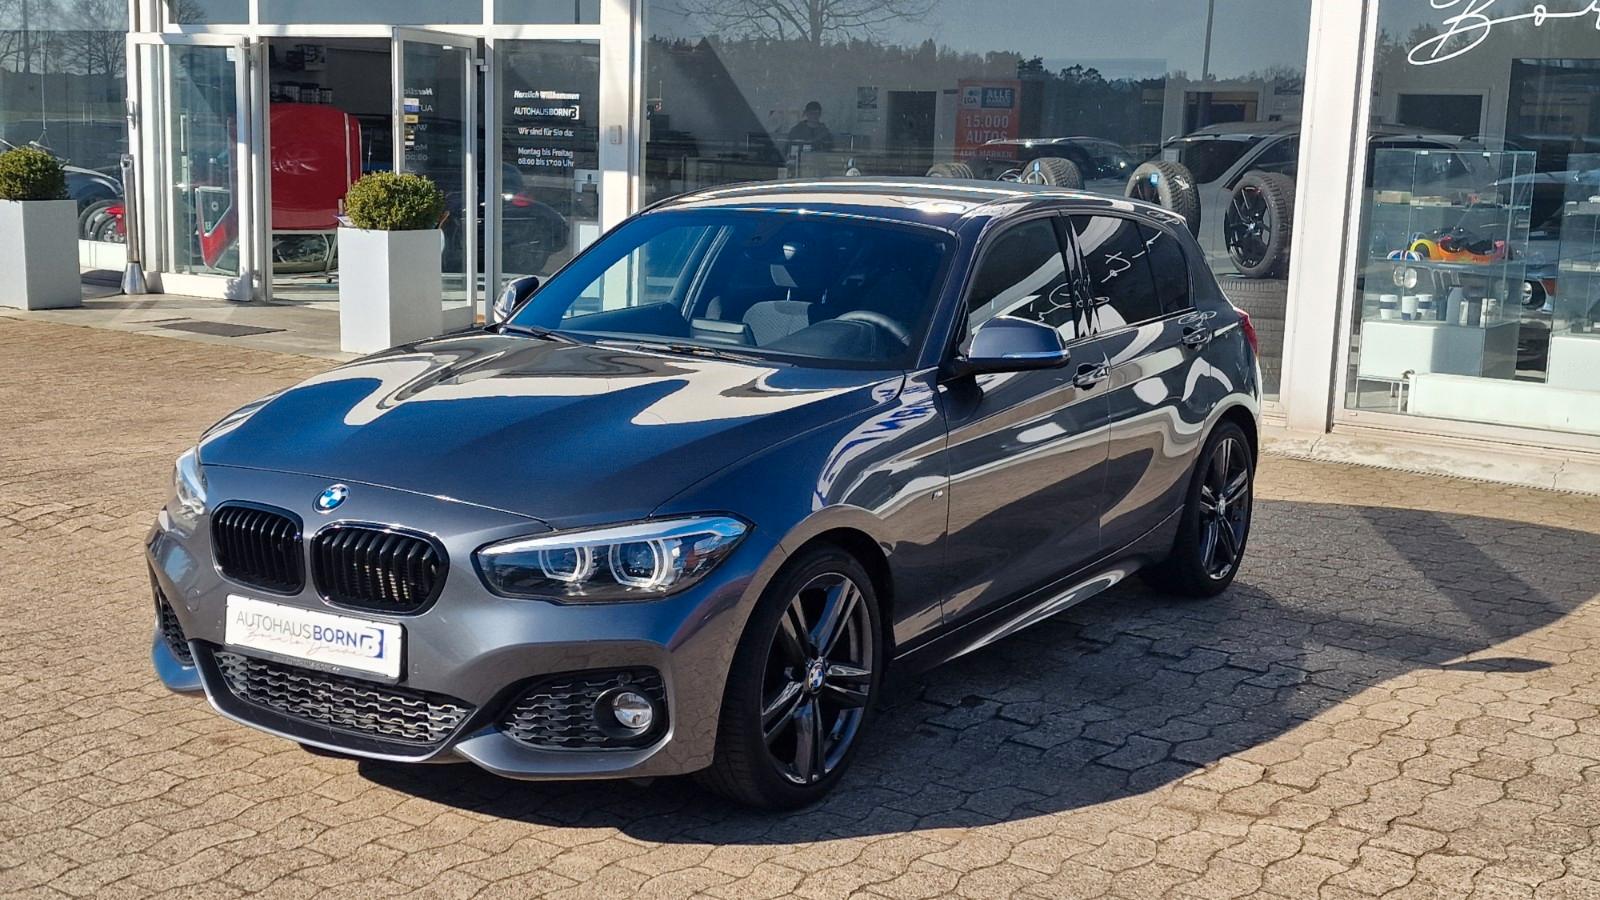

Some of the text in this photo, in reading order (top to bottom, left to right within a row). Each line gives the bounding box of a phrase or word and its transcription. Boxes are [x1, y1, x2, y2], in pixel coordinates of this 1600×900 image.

[514, 90, 539, 99] Herzlich
[966, 114, 1009, 129] 15.000
[518, 127, 529, 135] Wir
[529, 128, 543, 136] sind
[543, 128, 553, 136] für
[553, 128, 563, 137] Sie
[967, 130, 1008, 144] AUTOS
[518, 147, 574, 159] Montag bis Freitag
[535, 158, 545, 166] bis
[563, 159, 574, 168] Uhr
